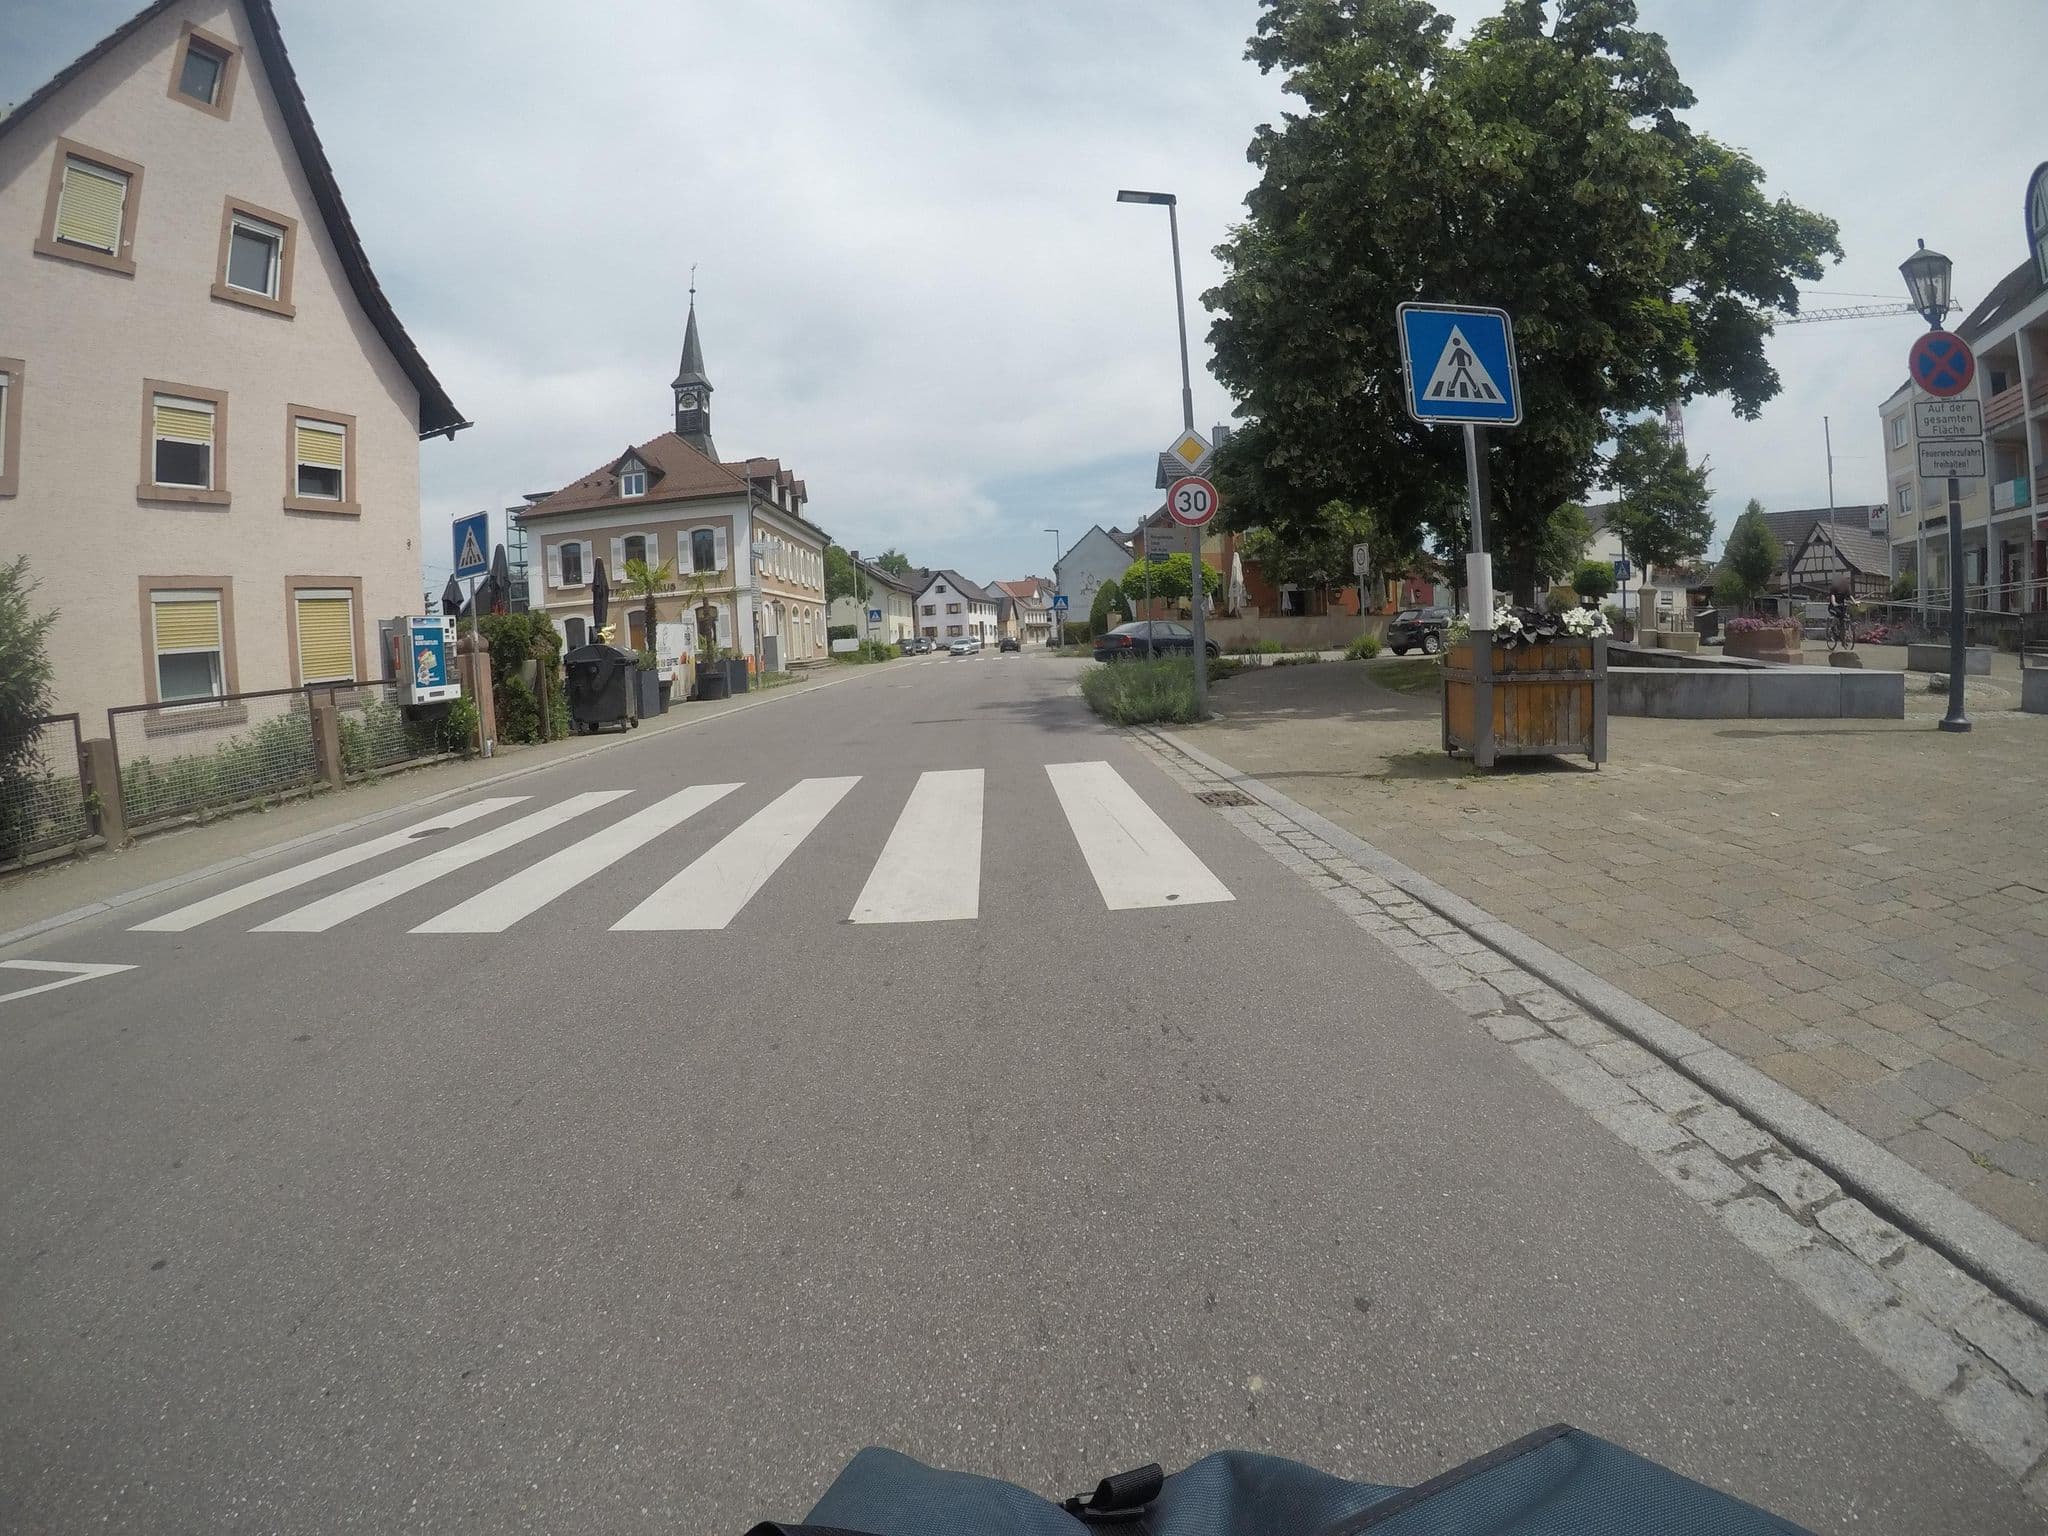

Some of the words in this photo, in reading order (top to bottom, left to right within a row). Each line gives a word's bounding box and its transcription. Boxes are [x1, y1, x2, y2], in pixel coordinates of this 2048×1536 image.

[1928, 404, 1945, 413] Auf
[1949, 403, 1967, 412] der
[1923, 415, 1973, 426] gesamten
[1932, 425, 1966, 434] Fläche
[1178, 490, 1207, 512] 30
